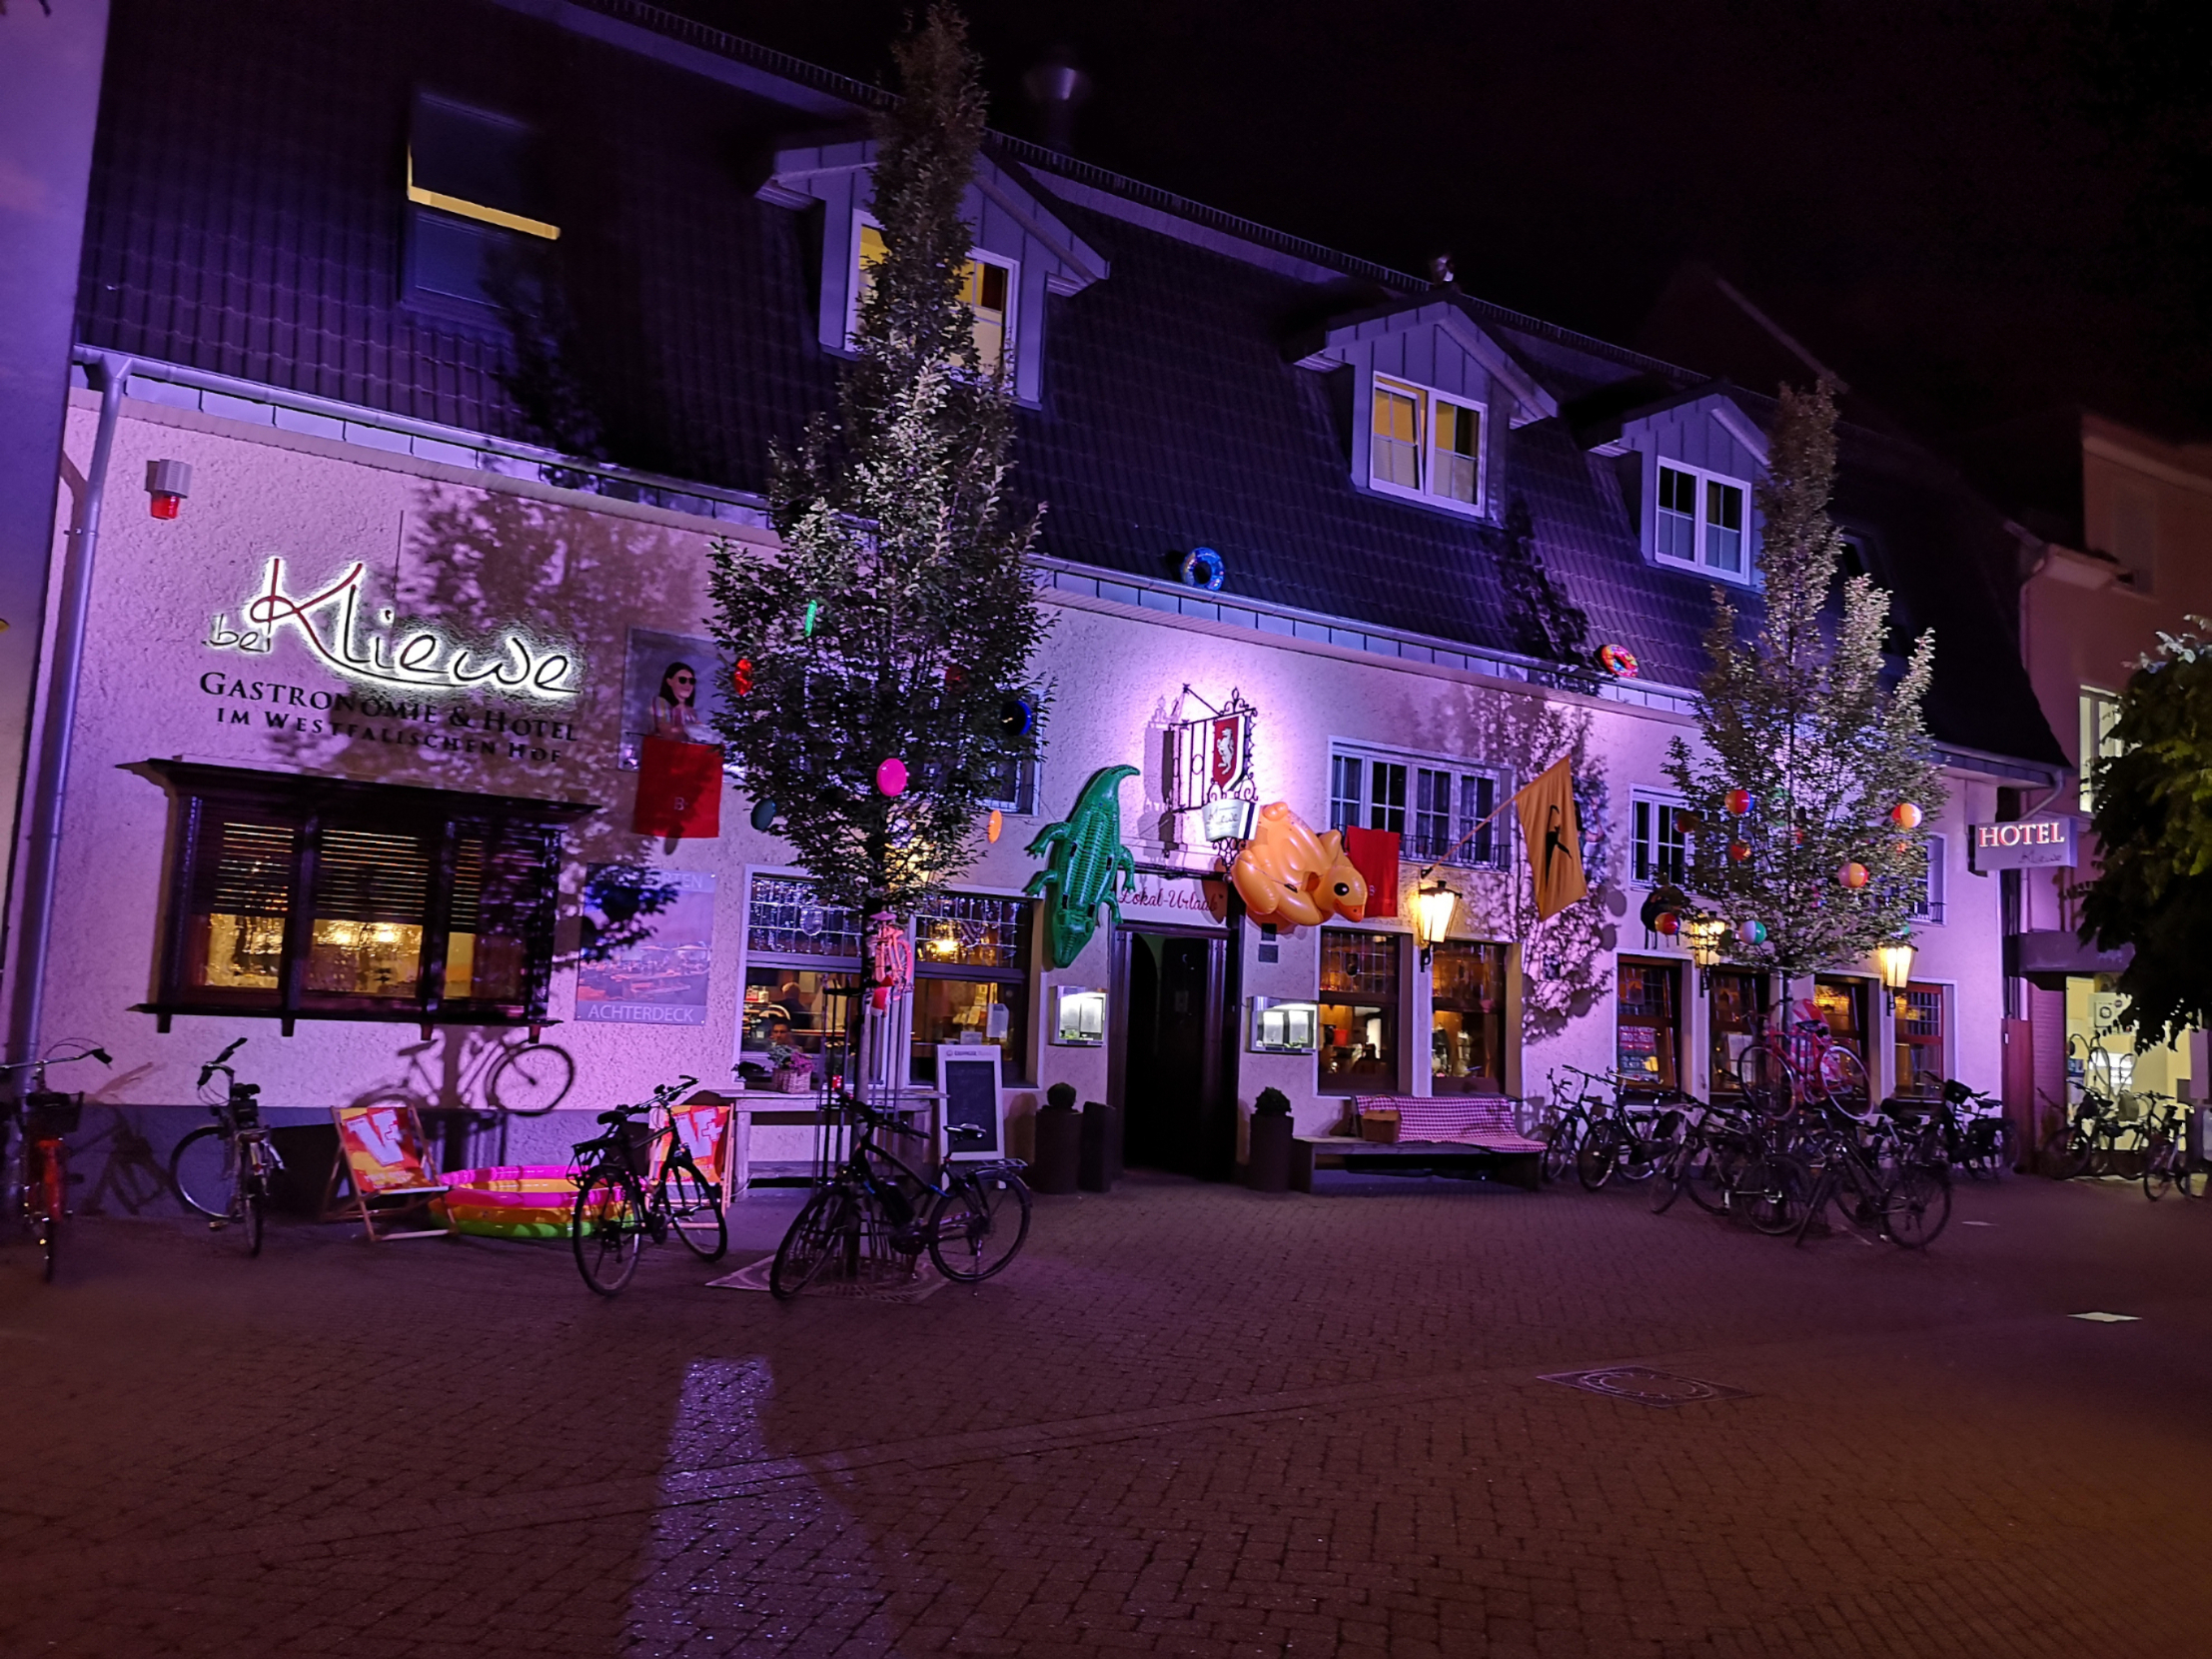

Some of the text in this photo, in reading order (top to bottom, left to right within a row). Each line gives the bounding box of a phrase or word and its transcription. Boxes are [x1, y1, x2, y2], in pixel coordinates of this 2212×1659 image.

[201, 558, 581, 694] bei Kliewe
[200, 672, 578, 743] GASTRONOMIE & HOTEL
[217, 708, 251, 726] IM
[509, 742, 561, 763] HOF
[1978, 822, 2065, 847] HOTEL
[1117, 886, 1218, 912] Lokal-Urlaub
[587, 1003, 694, 1023] ACHTERDECK
